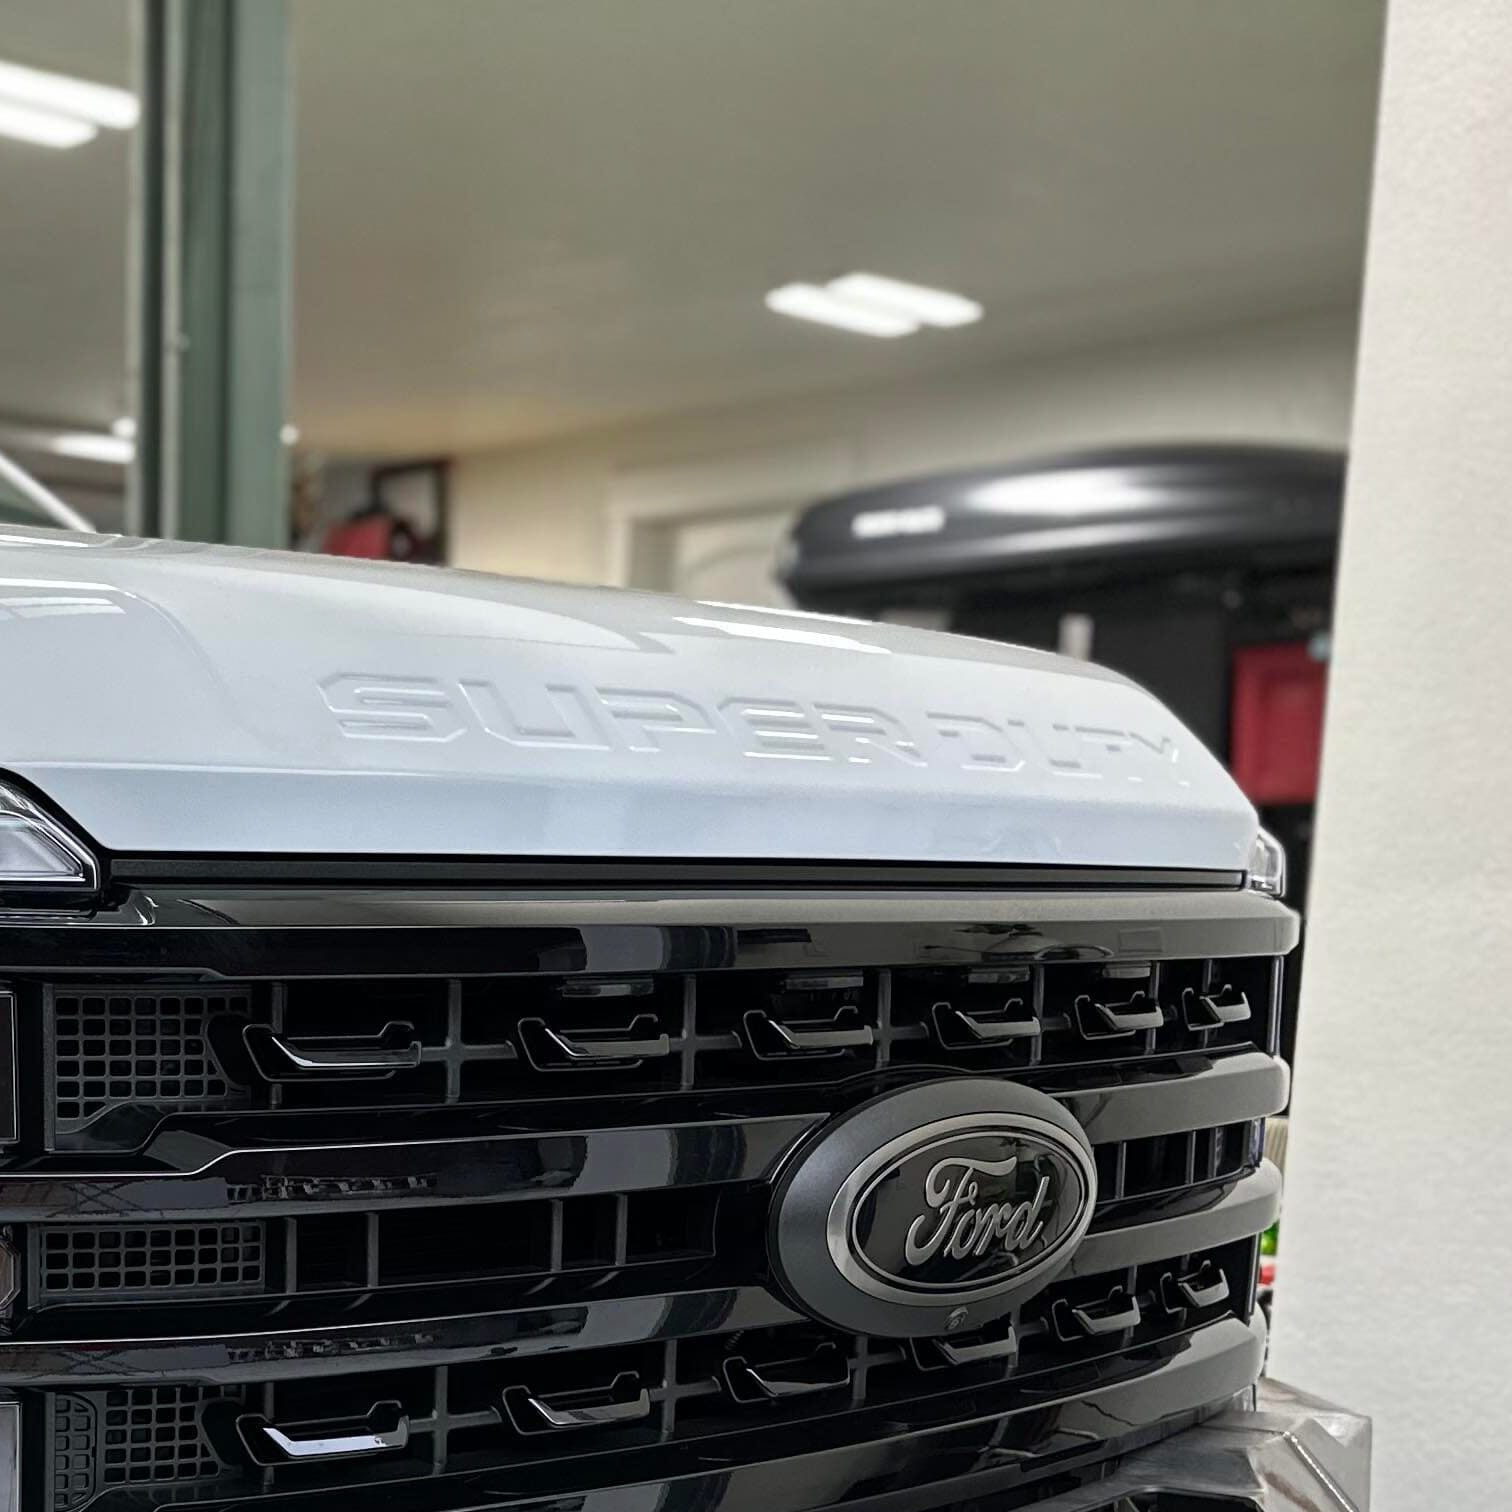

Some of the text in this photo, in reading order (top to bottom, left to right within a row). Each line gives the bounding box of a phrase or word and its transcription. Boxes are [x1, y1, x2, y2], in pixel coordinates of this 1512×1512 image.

[316, 672, 1191, 788] SUPER DUTY
[905, 1155, 1050, 1266] Ford
